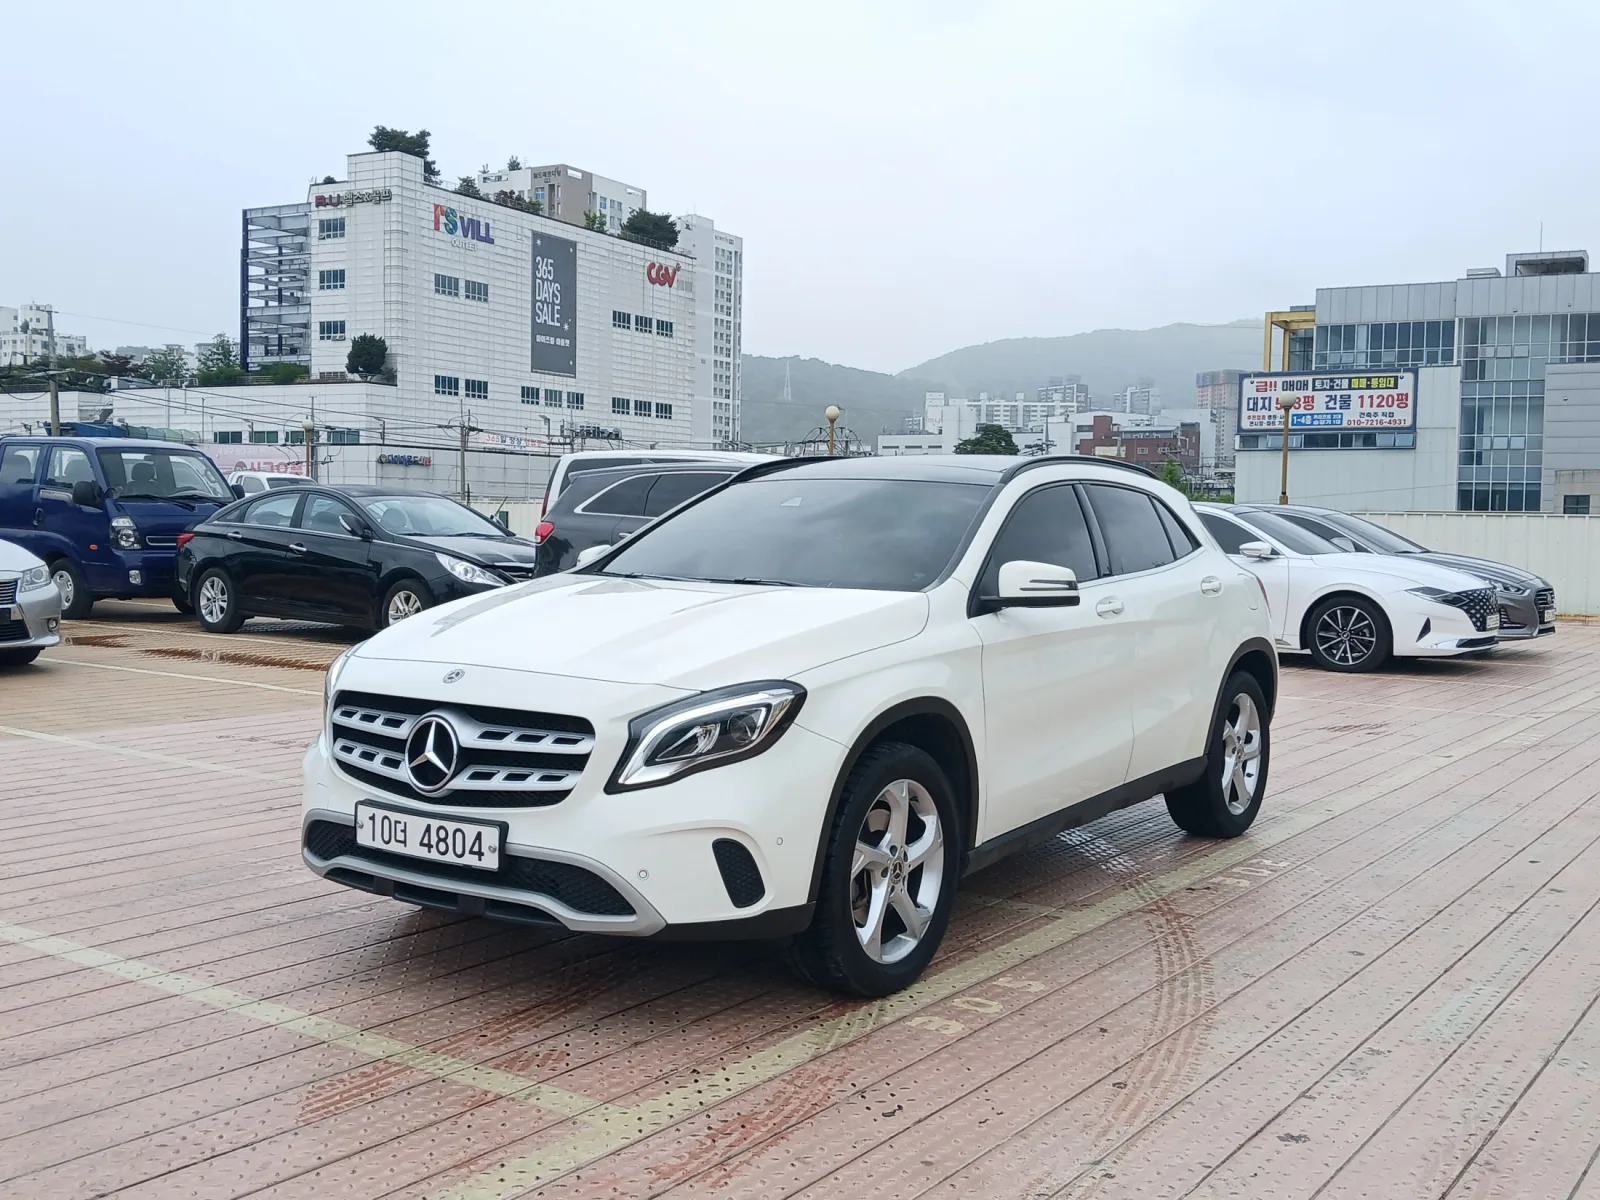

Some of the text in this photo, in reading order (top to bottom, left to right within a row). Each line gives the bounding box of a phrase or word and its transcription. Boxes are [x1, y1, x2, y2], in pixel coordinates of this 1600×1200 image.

[459, 215, 495, 245] VILL
[451, 238, 478, 252] OUTLET
[535, 256, 554, 280] 365
[647, 262, 676, 288] CGV
[535, 279, 561, 304] DAYS
[535, 302, 561, 327] SALE
[1255, 380, 1278, 393] 급!!
[1281, 379, 1309, 392] 매매
[1246, 392, 1409, 412] 대지 53평 건물 1120평
[1346, 418, 1407, 426] 010-7216-4931
[368, 812, 485, 862] 10더 4804
